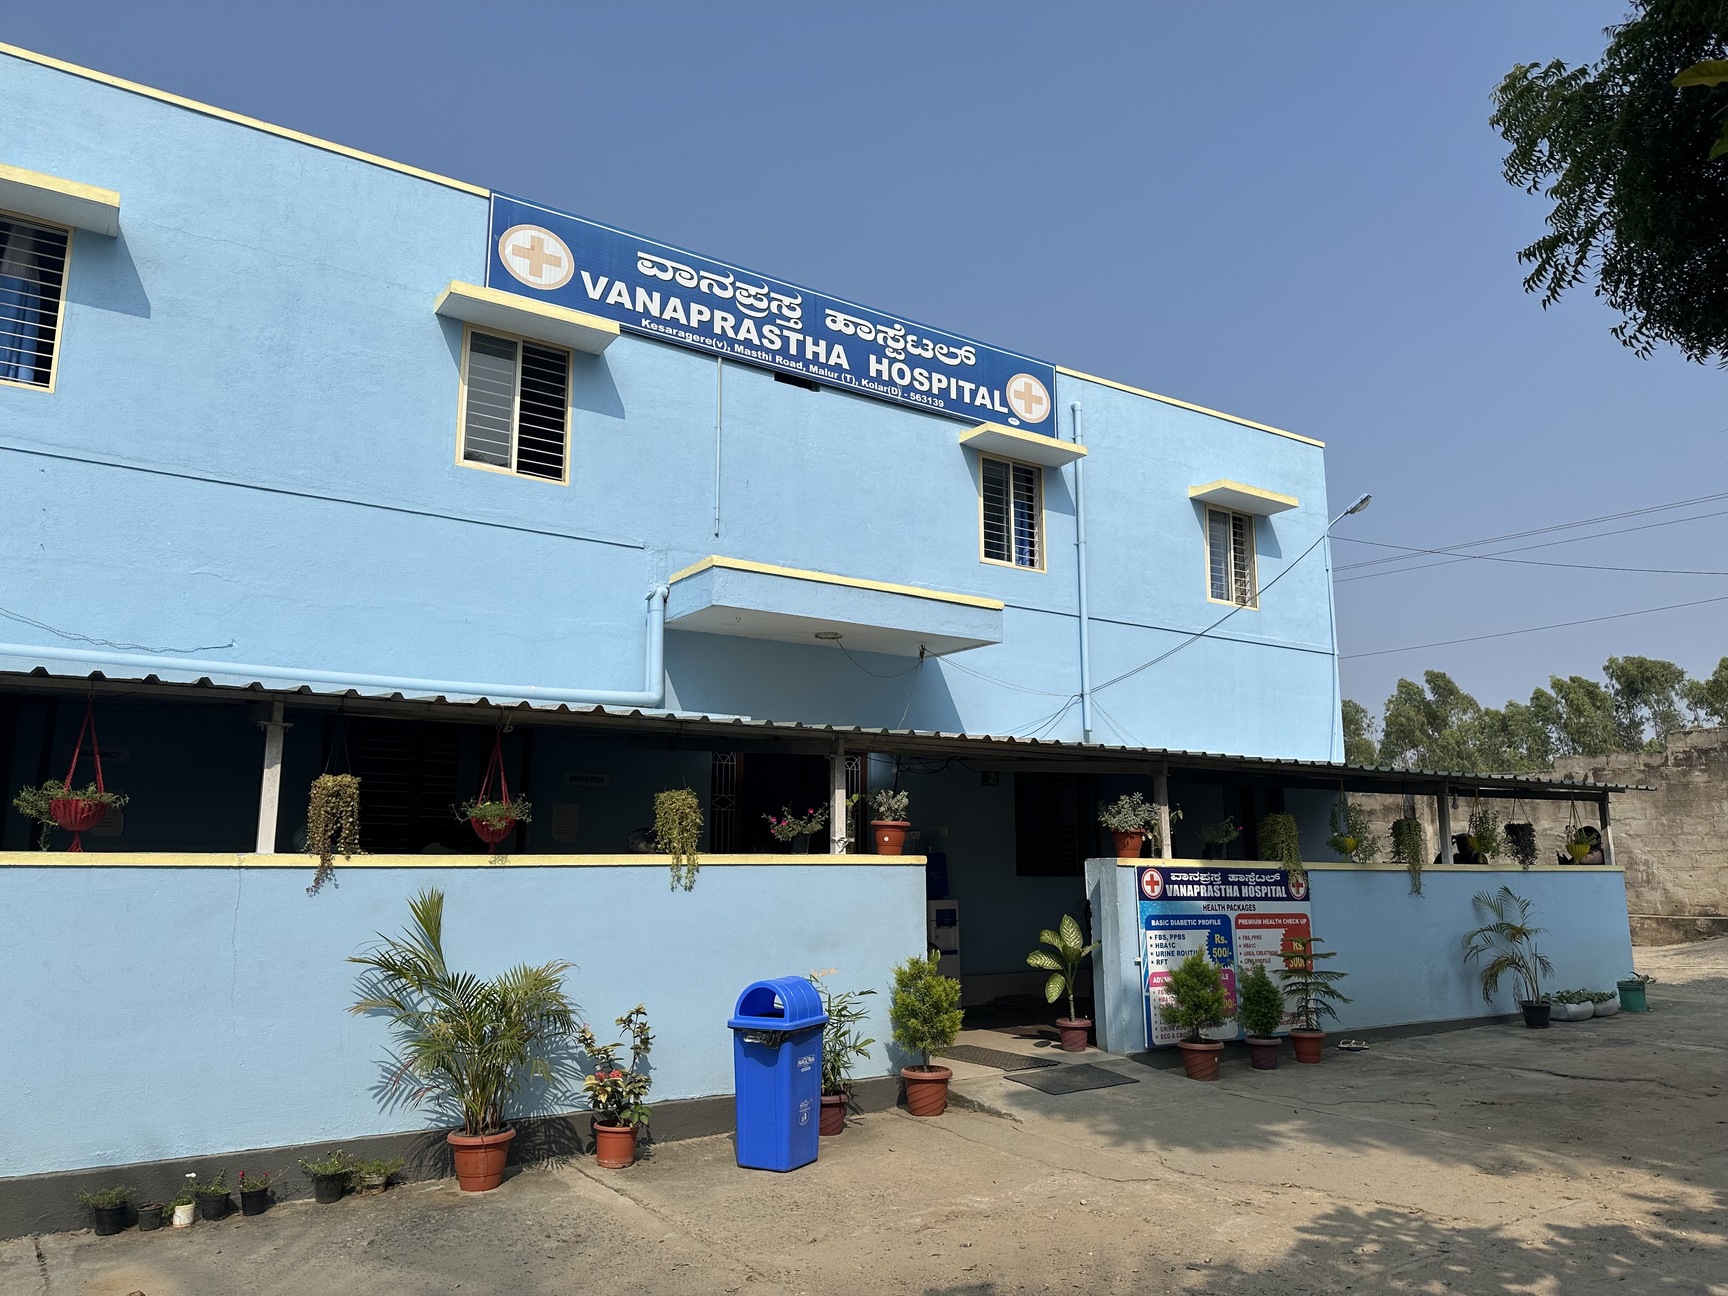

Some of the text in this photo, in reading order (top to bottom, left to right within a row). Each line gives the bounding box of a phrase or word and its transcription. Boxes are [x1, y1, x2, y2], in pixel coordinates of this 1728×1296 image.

[580, 270, 1008, 413] VANAPRASTHA HOSPITAL
[825, 309, 976, 366] ಹಾಸ್ಪೆಟಲ್
[641, 318, 731, 352] Kesaragere(v),
[734, 343, 772, 362] Masthi
[775, 355, 806, 372] Road,
[809, 364, 839, 379] Malur
[841, 372, 859, 386] (T),
[861, 378, 902, 398] Kolar(D)
[910, 391, 945, 408] 563139
[569, 775, 605, 783] RECEPTION
[1165, 884, 1287, 898] VANAPRASTHA HOSPITAL
[1202, 903, 1257, 912] HEALTH PACKAGES
[1170, 933, 1186, 941] PPBS
[1214, 934, 1228, 944] Rs.
[1212, 947, 1232, 958] 500/-
